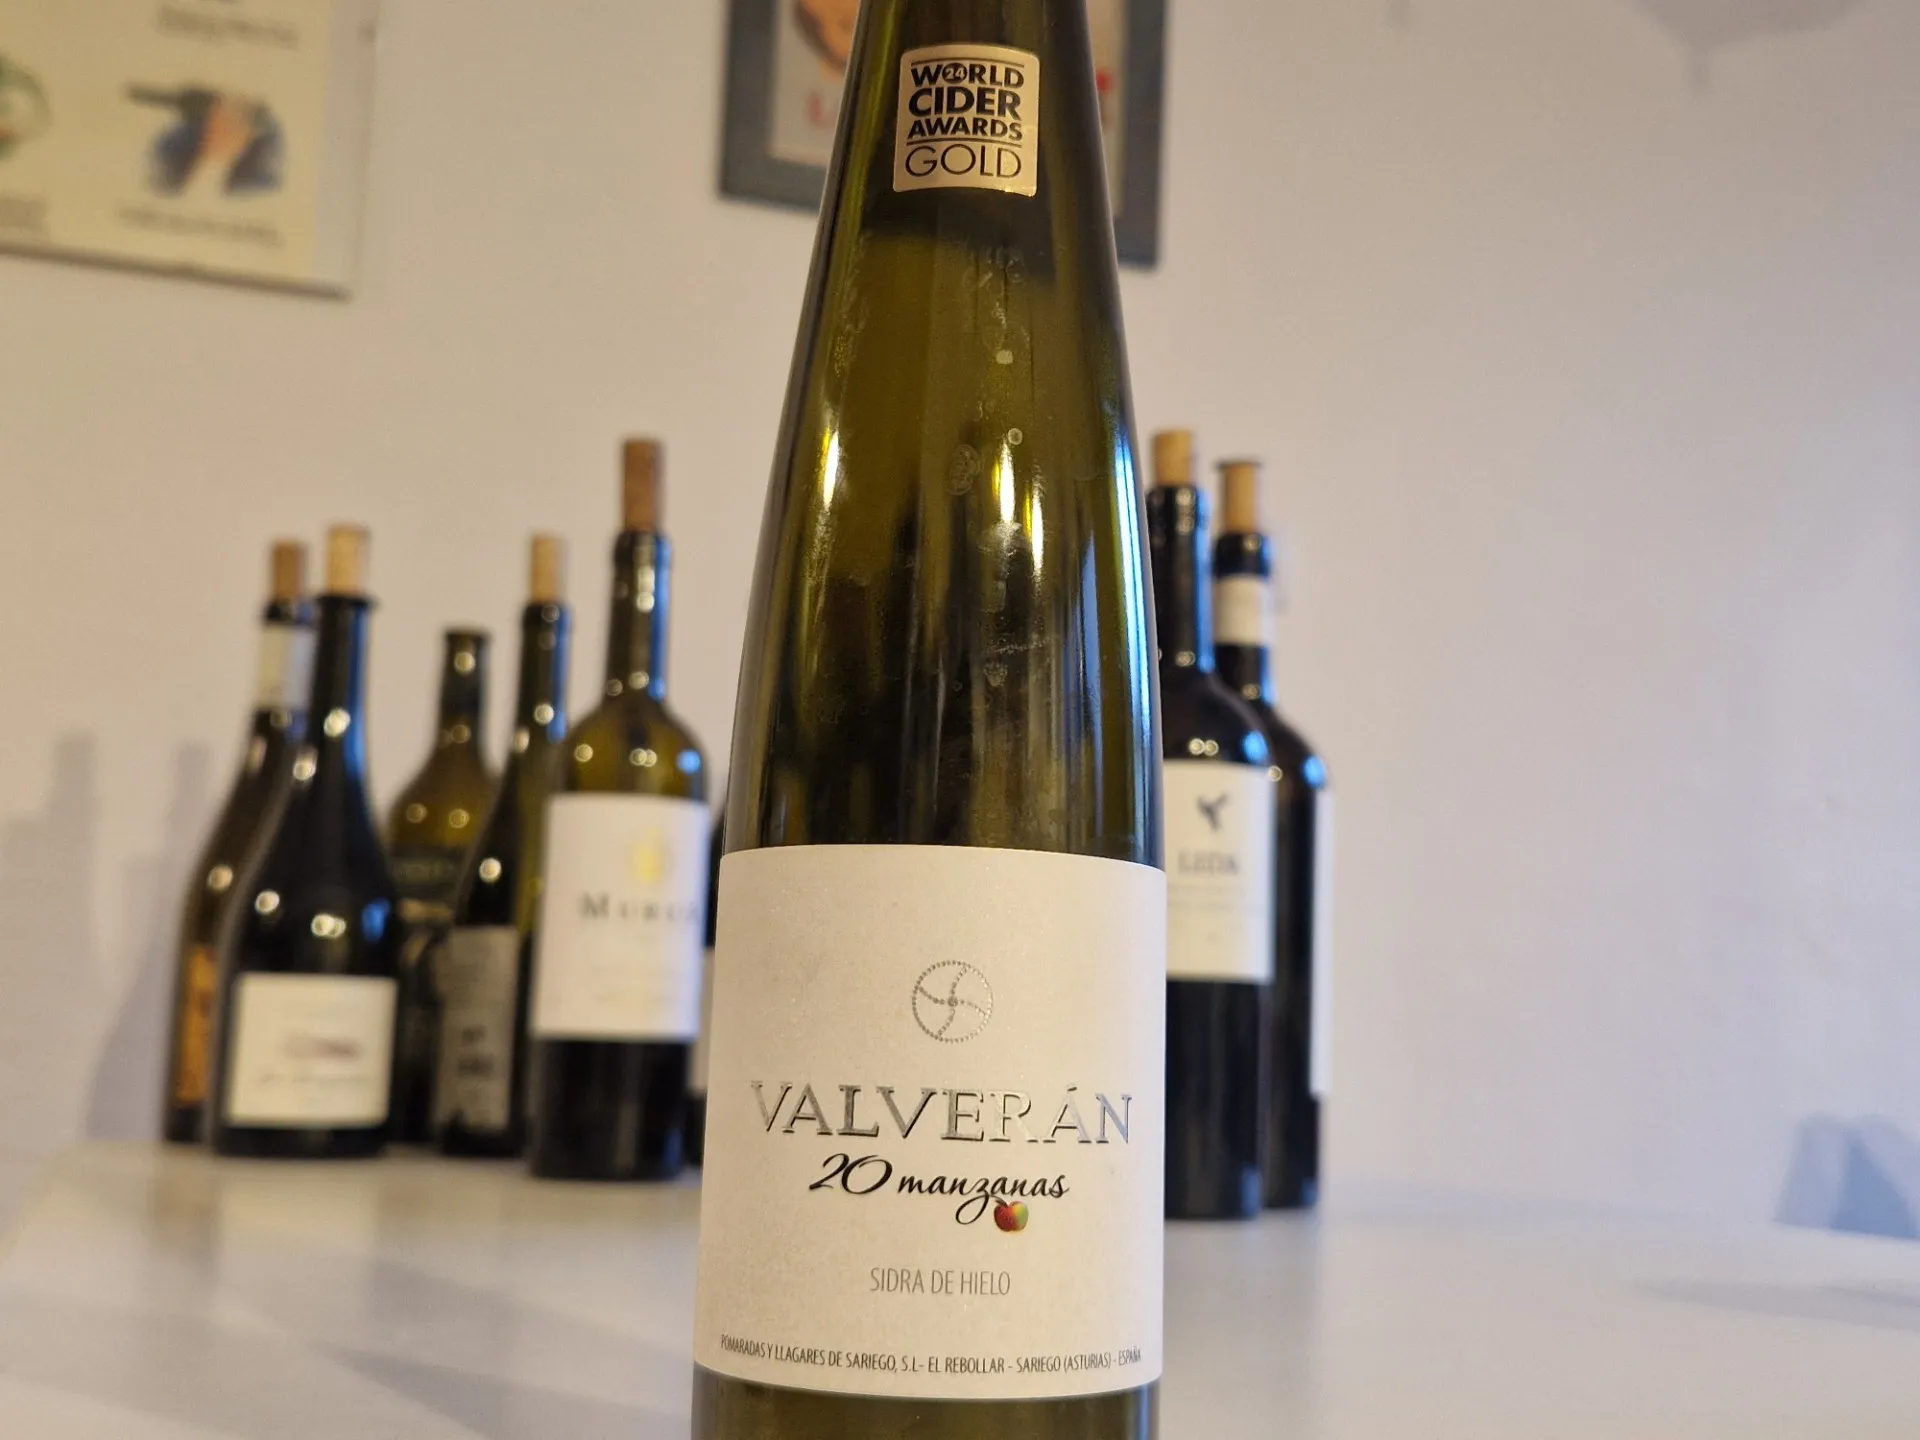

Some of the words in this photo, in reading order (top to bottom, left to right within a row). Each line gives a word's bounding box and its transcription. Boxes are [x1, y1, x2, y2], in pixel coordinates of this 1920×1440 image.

[911, 63, 1025, 89] WORLD
[908, 86, 1022, 121] CIDER
[907, 116, 1023, 141] AWARDS
[905, 143, 1022, 178] GOLD
[750, 1080, 1133, 1145] VALVERÁN
[808, 1152, 894, 1195] 20
[897, 1173, 1070, 1225] manzanas
[870, 1267, 925, 1294] SIDRA
[931, 1269, 955, 1295] DE
[960, 1270, 1011, 1296] HIELO
[721, 1333, 766, 1358] POMARADAS
[766, 1342, 773, 1359] Y
[774, 1344, 826, 1367] LLAGARES
[828, 1350, 843, 1367] DE
[845, 1351, 899, 1373] SARIEGO,
[927, 1356, 942, 1373] EL
[944, 1356, 1006, 1374] REBOLLAR
[1016, 1355, 1062, 1374] SARIEGO
[1063, 1353, 1112, 1373] (ASTURIAS)
[1118, 1346, 1142, 1367] ESPAÑA
